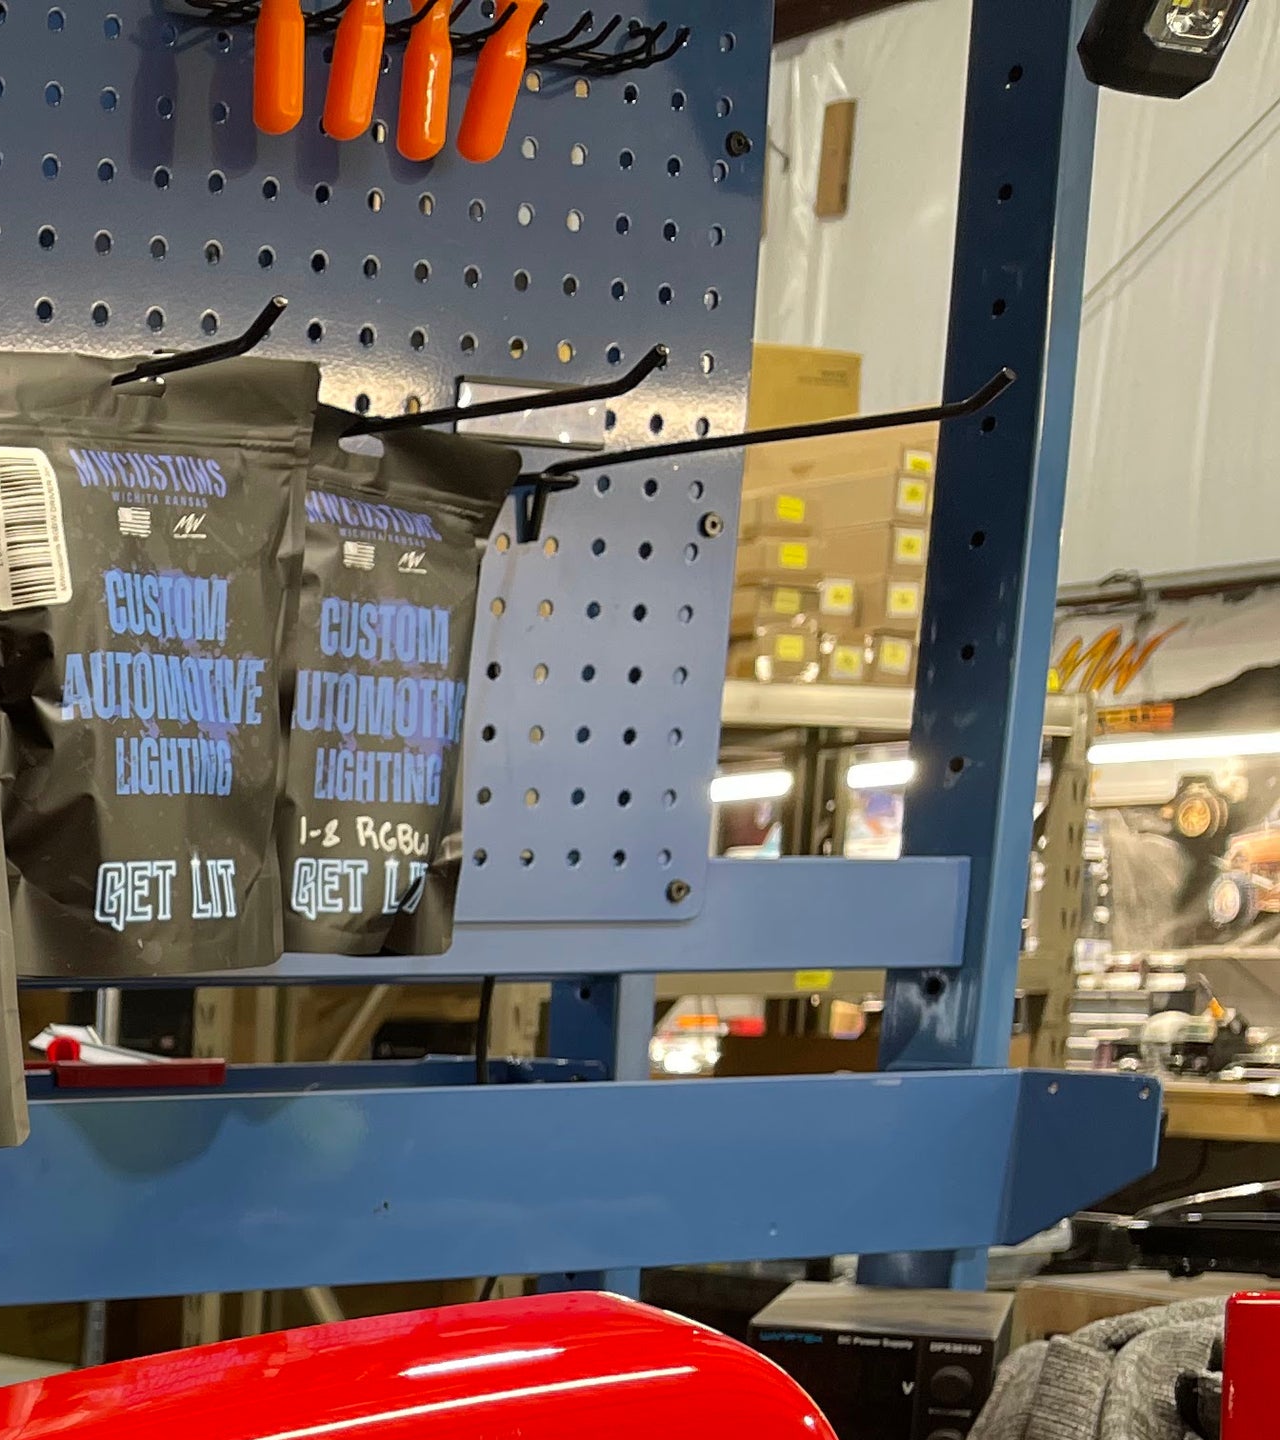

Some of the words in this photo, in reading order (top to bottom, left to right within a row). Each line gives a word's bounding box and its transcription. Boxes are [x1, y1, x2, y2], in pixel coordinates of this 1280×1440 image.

[69, 448, 227, 498] MWCUSTOMS
[112, 491, 159, 505] WICHITA
[165, 495, 208, 508] KANSAS
[173, 512, 207, 534] MW
[105, 570, 229, 643] CUSTOM
[320, 597, 450, 664] CUSTOM
[61, 651, 266, 726] AUTOMOTIVE
[115, 737, 233, 796] LIGHTING
[314, 747, 441, 805] LIGHTING
[356, 816, 429, 856] RGBW
[94, 859, 177, 932] GET
[191, 858, 237, 920] LIT
[291, 857, 368, 920] GET
[902, 1381, 914, 1396] V
